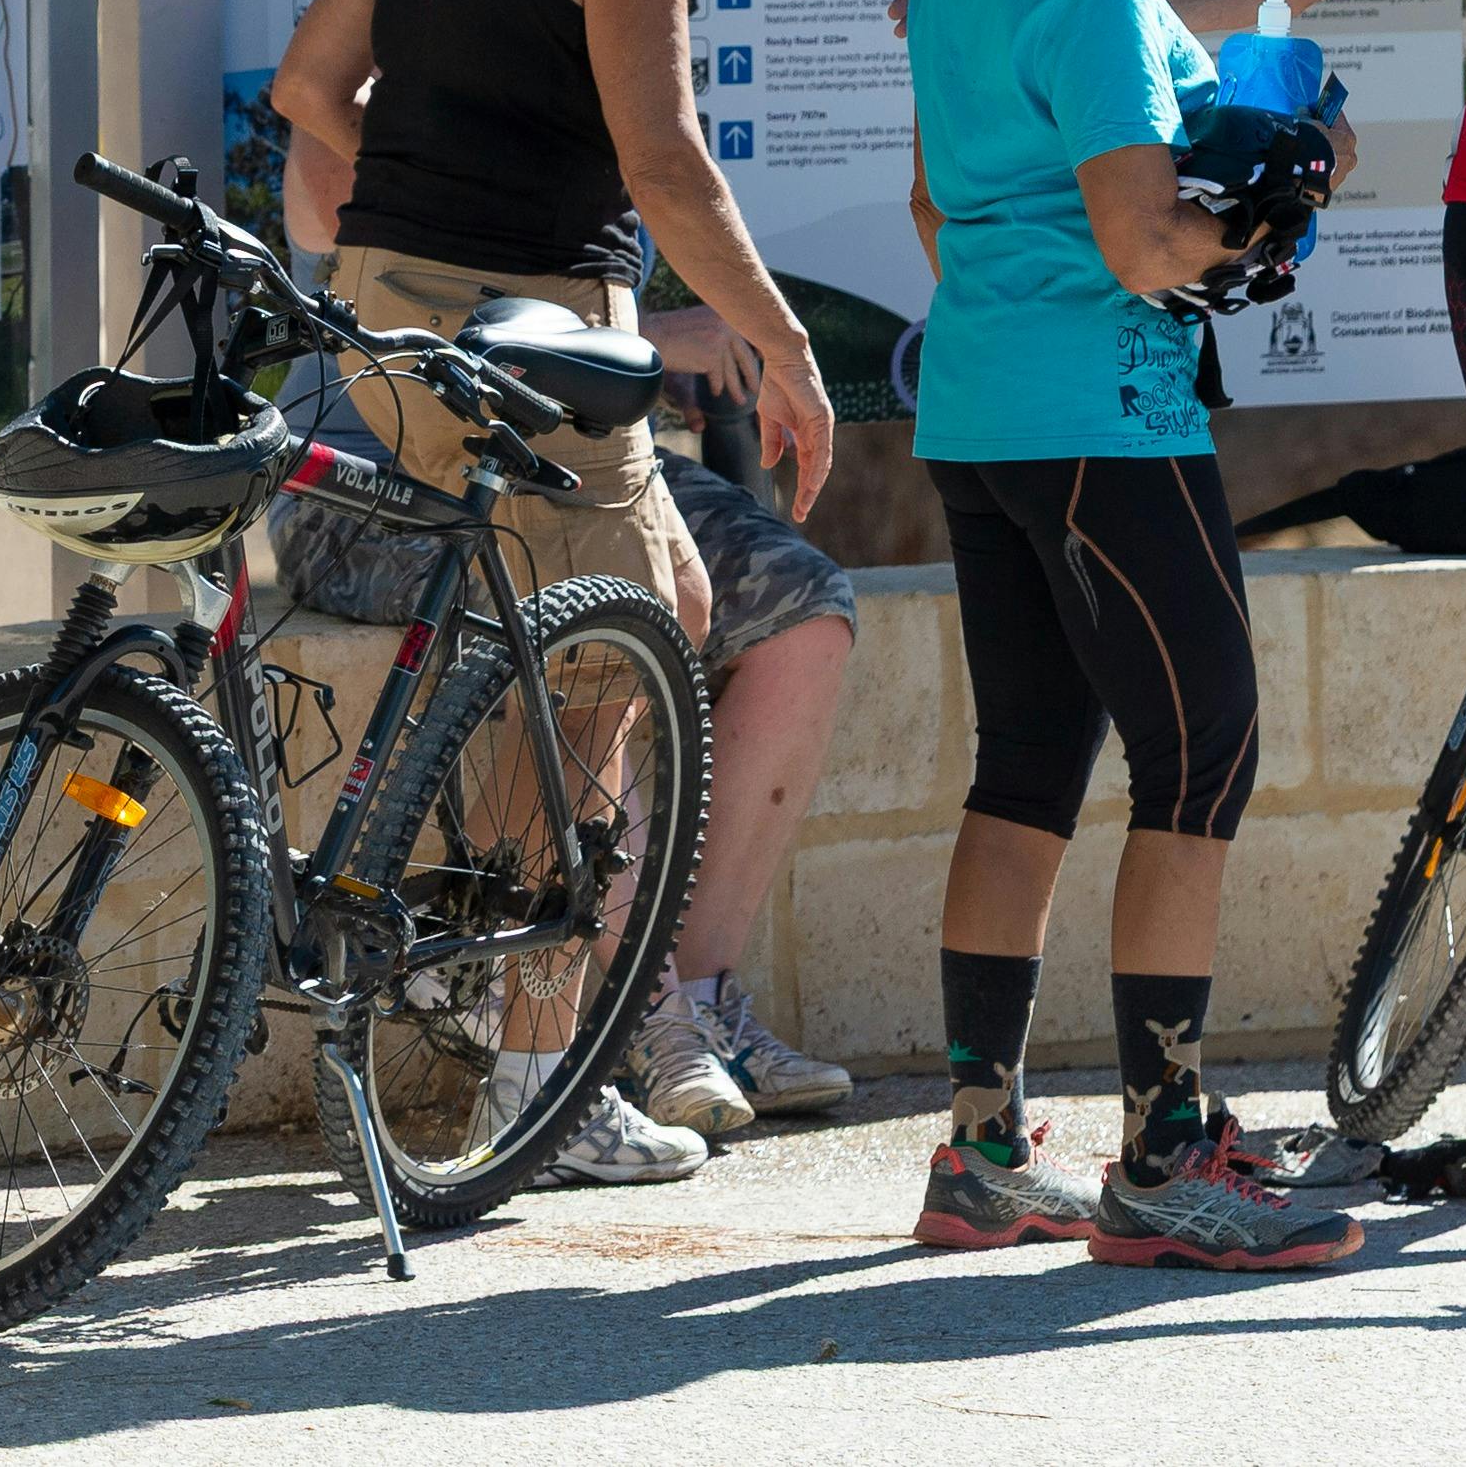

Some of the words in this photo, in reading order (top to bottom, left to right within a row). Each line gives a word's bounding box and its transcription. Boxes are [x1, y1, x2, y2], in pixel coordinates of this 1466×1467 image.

[1331, 309, 1392, 324] Department
[1393, 308, 1403, 321] of
[1331, 325, 1404, 338] Conservation
[1407, 324, 1426, 335] and
[335, 464, 414, 506] VOLATILE
[8, 501, 130, 517] SORELLI
